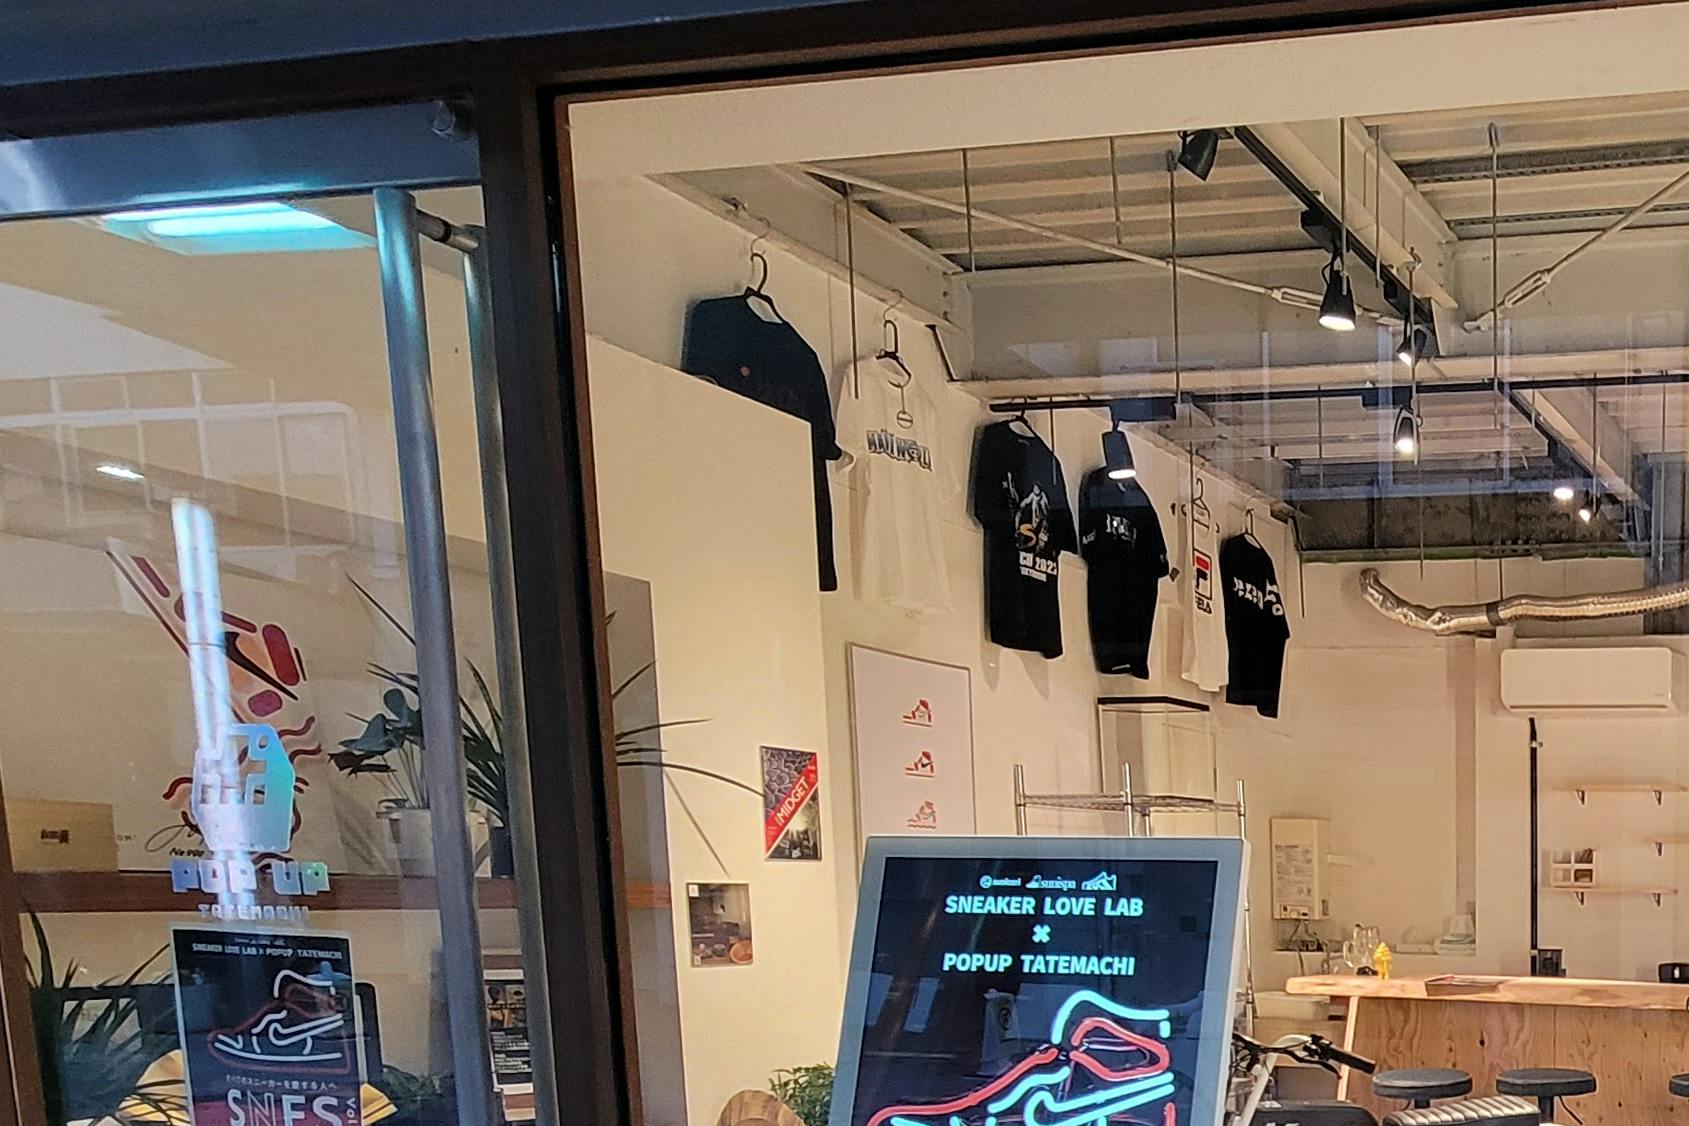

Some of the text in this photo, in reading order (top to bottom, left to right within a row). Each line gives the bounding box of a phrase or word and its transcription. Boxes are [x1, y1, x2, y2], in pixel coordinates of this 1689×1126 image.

[171, 859, 331, 896] POP UP
[945, 895, 1144, 917] SNEAKER LOVE LAB
[943, 952, 1136, 976] POPUP TATEMACHI
